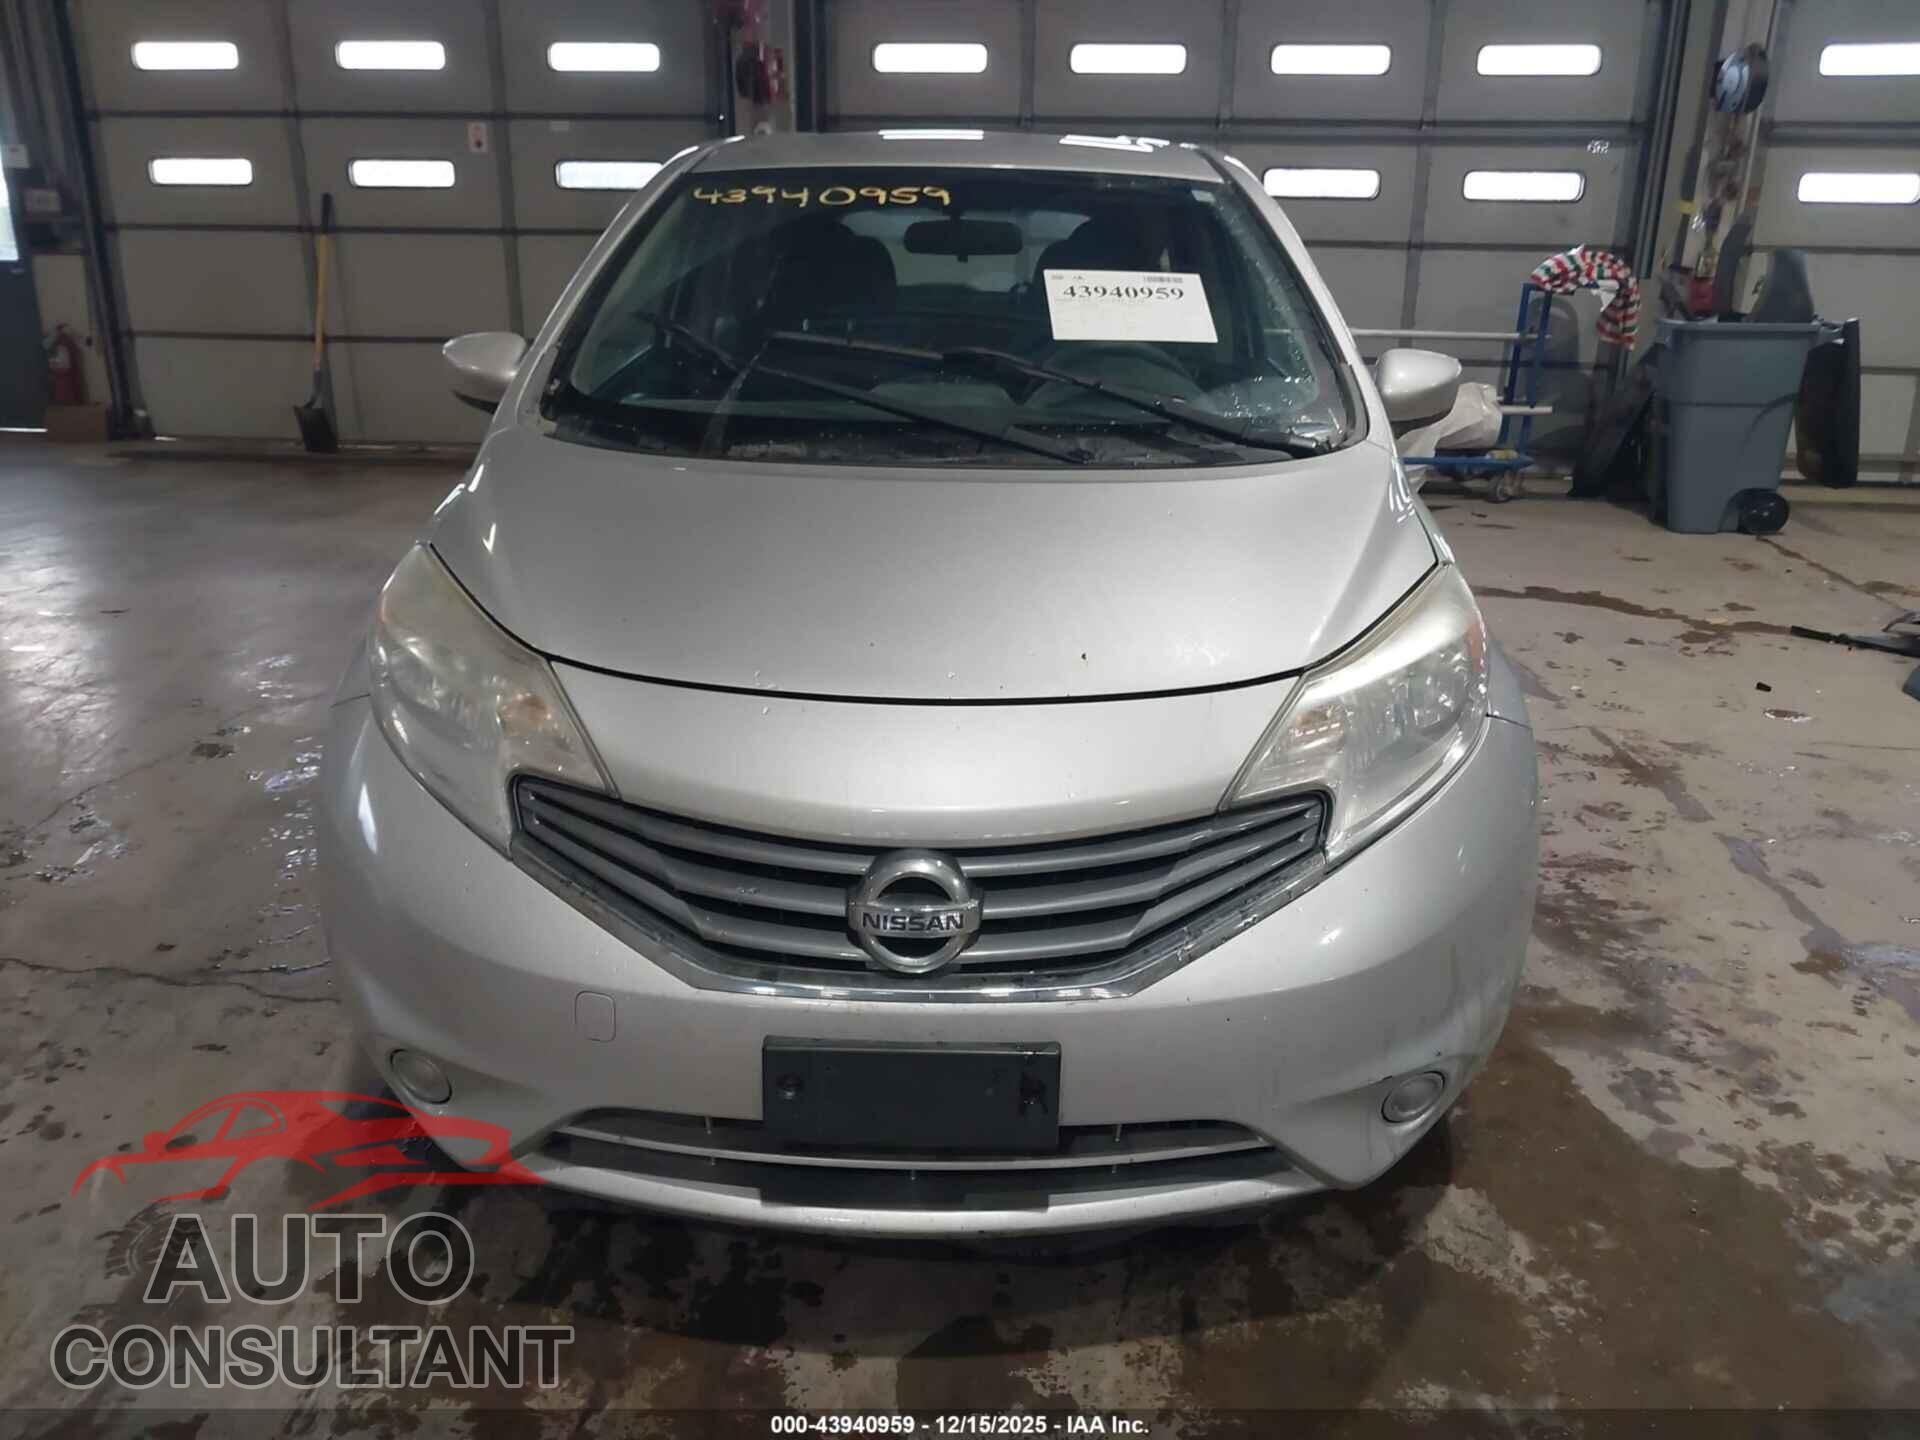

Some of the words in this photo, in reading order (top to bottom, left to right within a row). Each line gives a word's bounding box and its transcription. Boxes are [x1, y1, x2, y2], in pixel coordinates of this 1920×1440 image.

[693, 185, 951, 208] 43940959
[1062, 284, 1185, 301] 43940959
[861, 911, 965, 932] NISSAN
